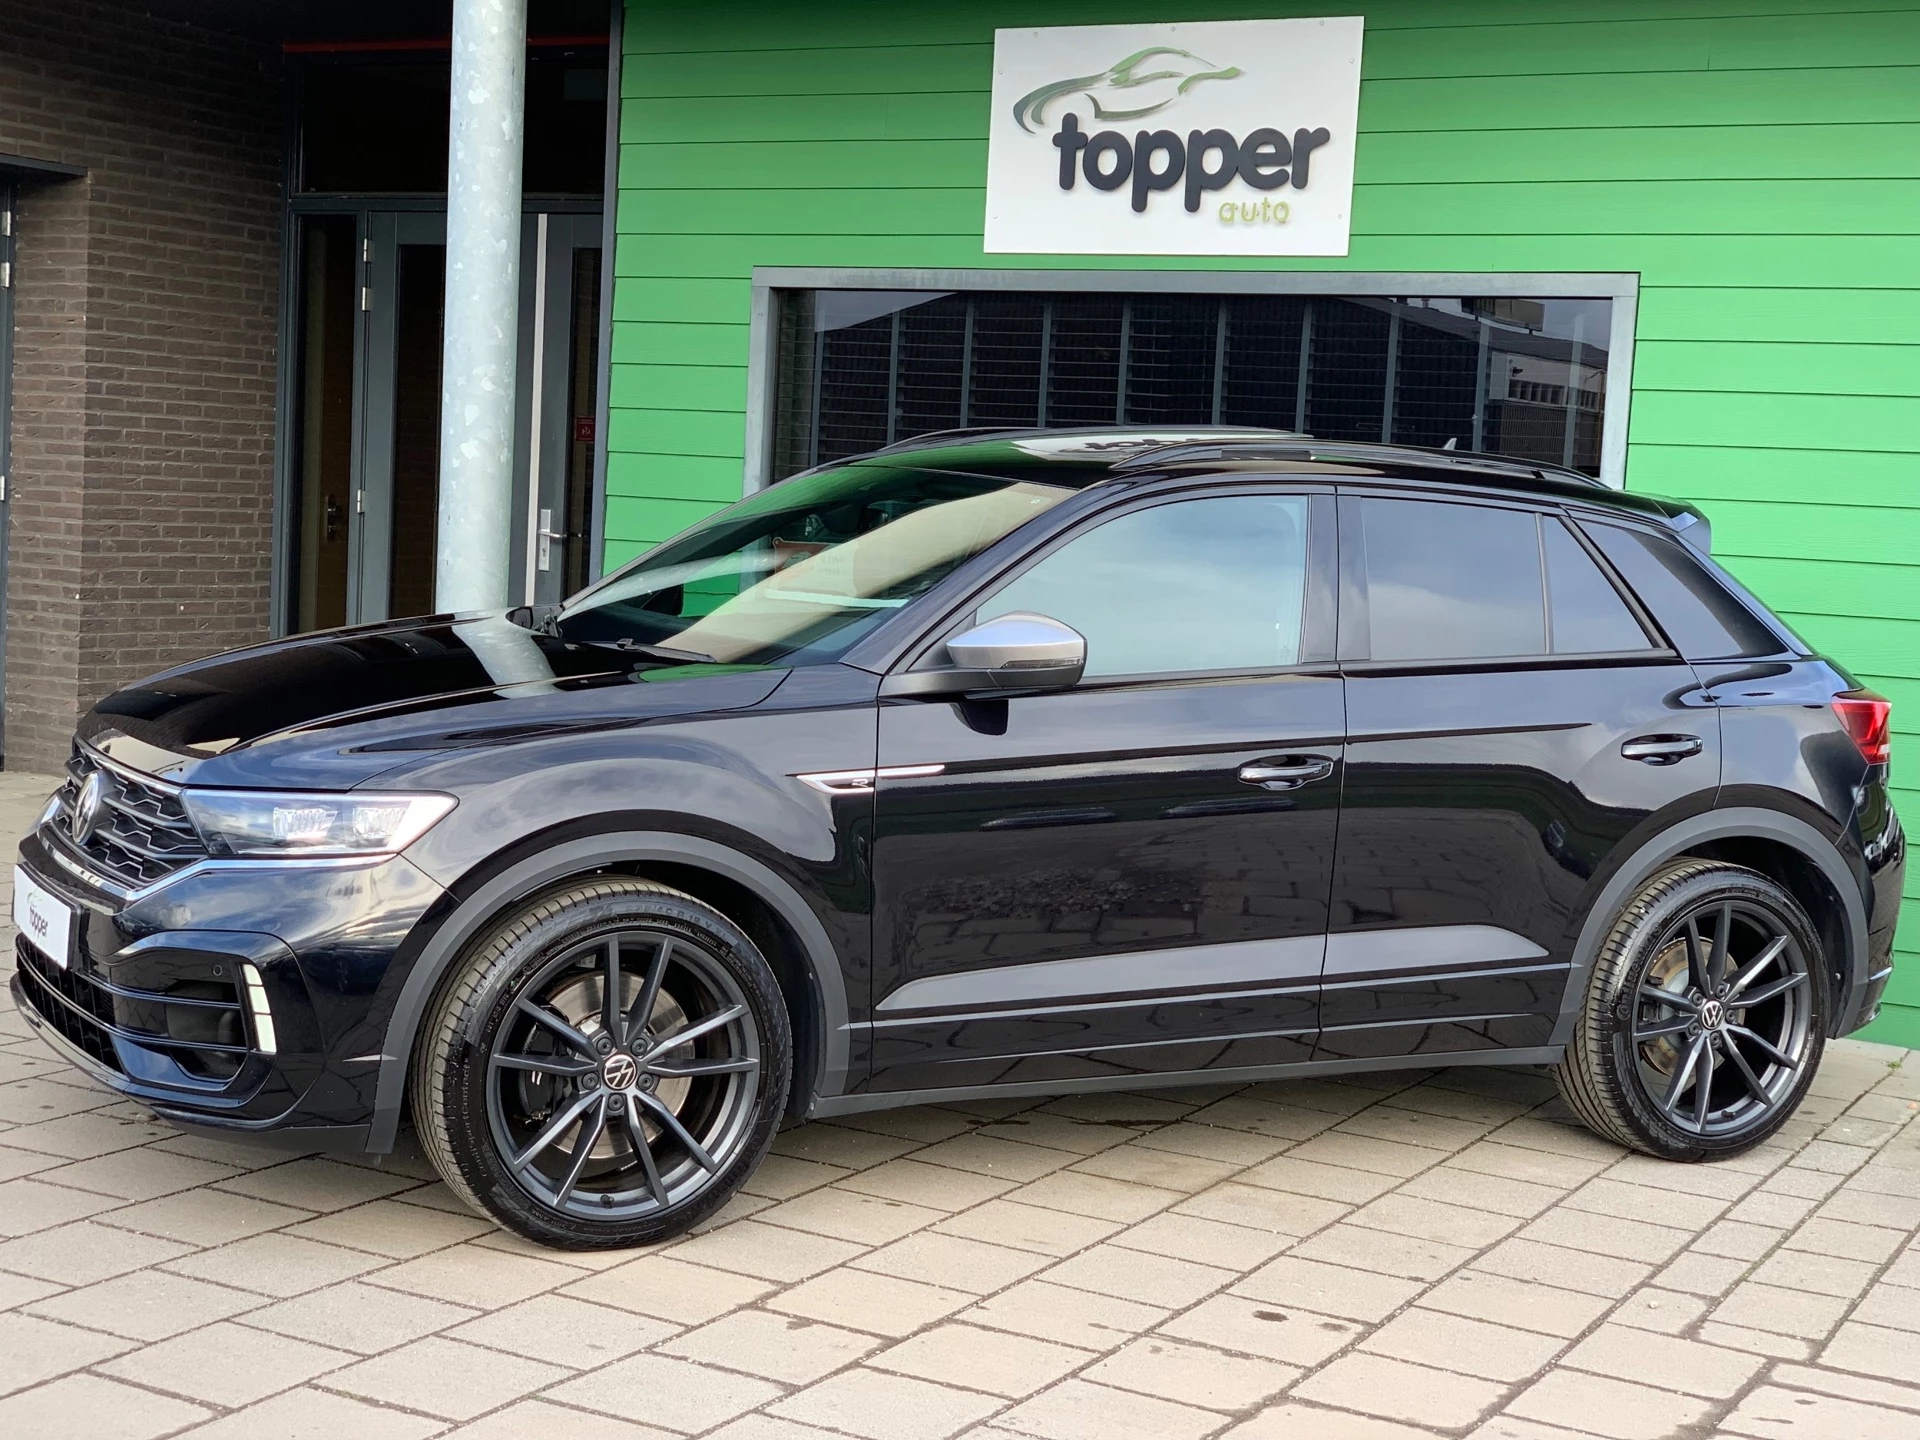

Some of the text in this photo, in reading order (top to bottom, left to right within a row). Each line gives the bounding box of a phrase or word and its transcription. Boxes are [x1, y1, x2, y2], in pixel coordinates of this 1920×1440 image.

[1052, 112, 1331, 213] topper
[1218, 197, 1291, 224] auto
[29, 905, 49, 939] topper
